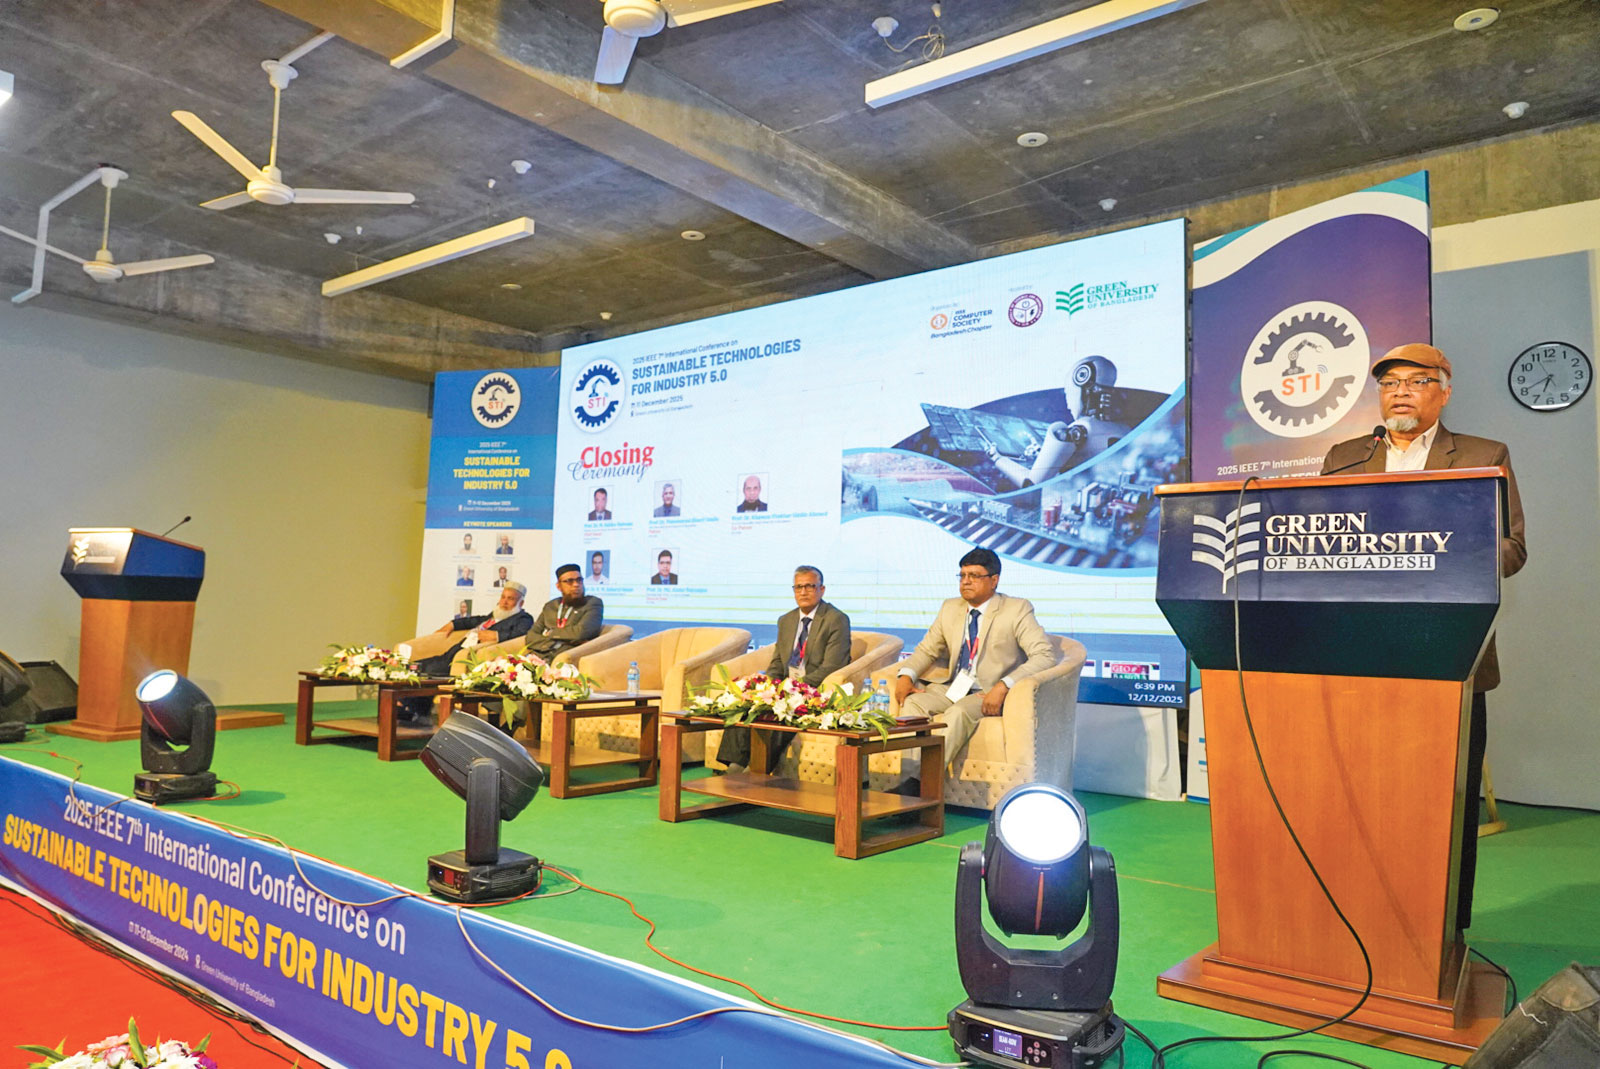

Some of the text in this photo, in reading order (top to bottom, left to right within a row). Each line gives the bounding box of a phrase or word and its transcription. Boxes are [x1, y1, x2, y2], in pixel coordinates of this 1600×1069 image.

[1087, 281, 1128, 295] GREEN
[1087, 284, 1158, 304] UNIVERSITY
[1100, 294, 1154, 306] BANGLADESH
[954, 310, 992, 321] COMPUTER
[952, 318, 981, 328] SOCIETY
[930, 325, 992, 338] Bangladesh Chapter
[646, 353, 657, 361] IEEE
[665, 346, 697, 358] International
[698, 341, 730, 352] Conference
[1544, 348, 1556, 358] 12
[1562, 350, 1566, 359] 1
[632, 339, 801, 380] SUSTAINABLE TECHNOLOGIES
[1532, 353, 1540, 362] 11
[1571, 358, 1580, 367] 2
[1521, 362, 1533, 372] 10
[1517, 376, 1526, 384] 9
[1574, 370, 1584, 380] 3
[632, 369, 728, 396] FOR INDUSTRY 5.0
[1282, 373, 1320, 396] STI
[1521, 387, 1528, 396] 8
[588, 397, 606, 408] STI
[642, 398, 668, 406] December
[1532, 395, 1541, 404] 7
[1546, 397, 1554, 405] 6
[1560, 393, 1569, 402] 5
[488, 401, 503, 409] STI
[464, 456, 520, 465] SUSTAINABLE
[580, 442, 655, 468] Closing
[567, 460, 647, 483] Ceremony
[1217, 456, 1325, 476] 2025 IEEE 7th Internation
[453, 468, 530, 478] TECHNOLOGIES FOR
[464, 481, 518, 489] INDUSTRY 5.0
[1265, 512, 1367, 535] GREEN
[1265, 532, 1453, 556] UNIVERSITY
[1266, 556, 1432, 570] OF BANGLADESH
[1128, 694, 1183, 703] 12/12/2025
[64, 794, 406, 955] 2025 IEEE 7th International Conference on
[3, 814, 106, 887] SUSTAINABLE
[109, 856, 260, 960] TECHNOLOGIES
[264, 923, 317, 989] FOR
[322, 948, 497, 1069] INDUSTRY
[146, 929, 173, 954] December
[215, 970, 239, 991] University
[239, 982, 245, 991] of
[245, 984, 275, 1008] Bangladesh
